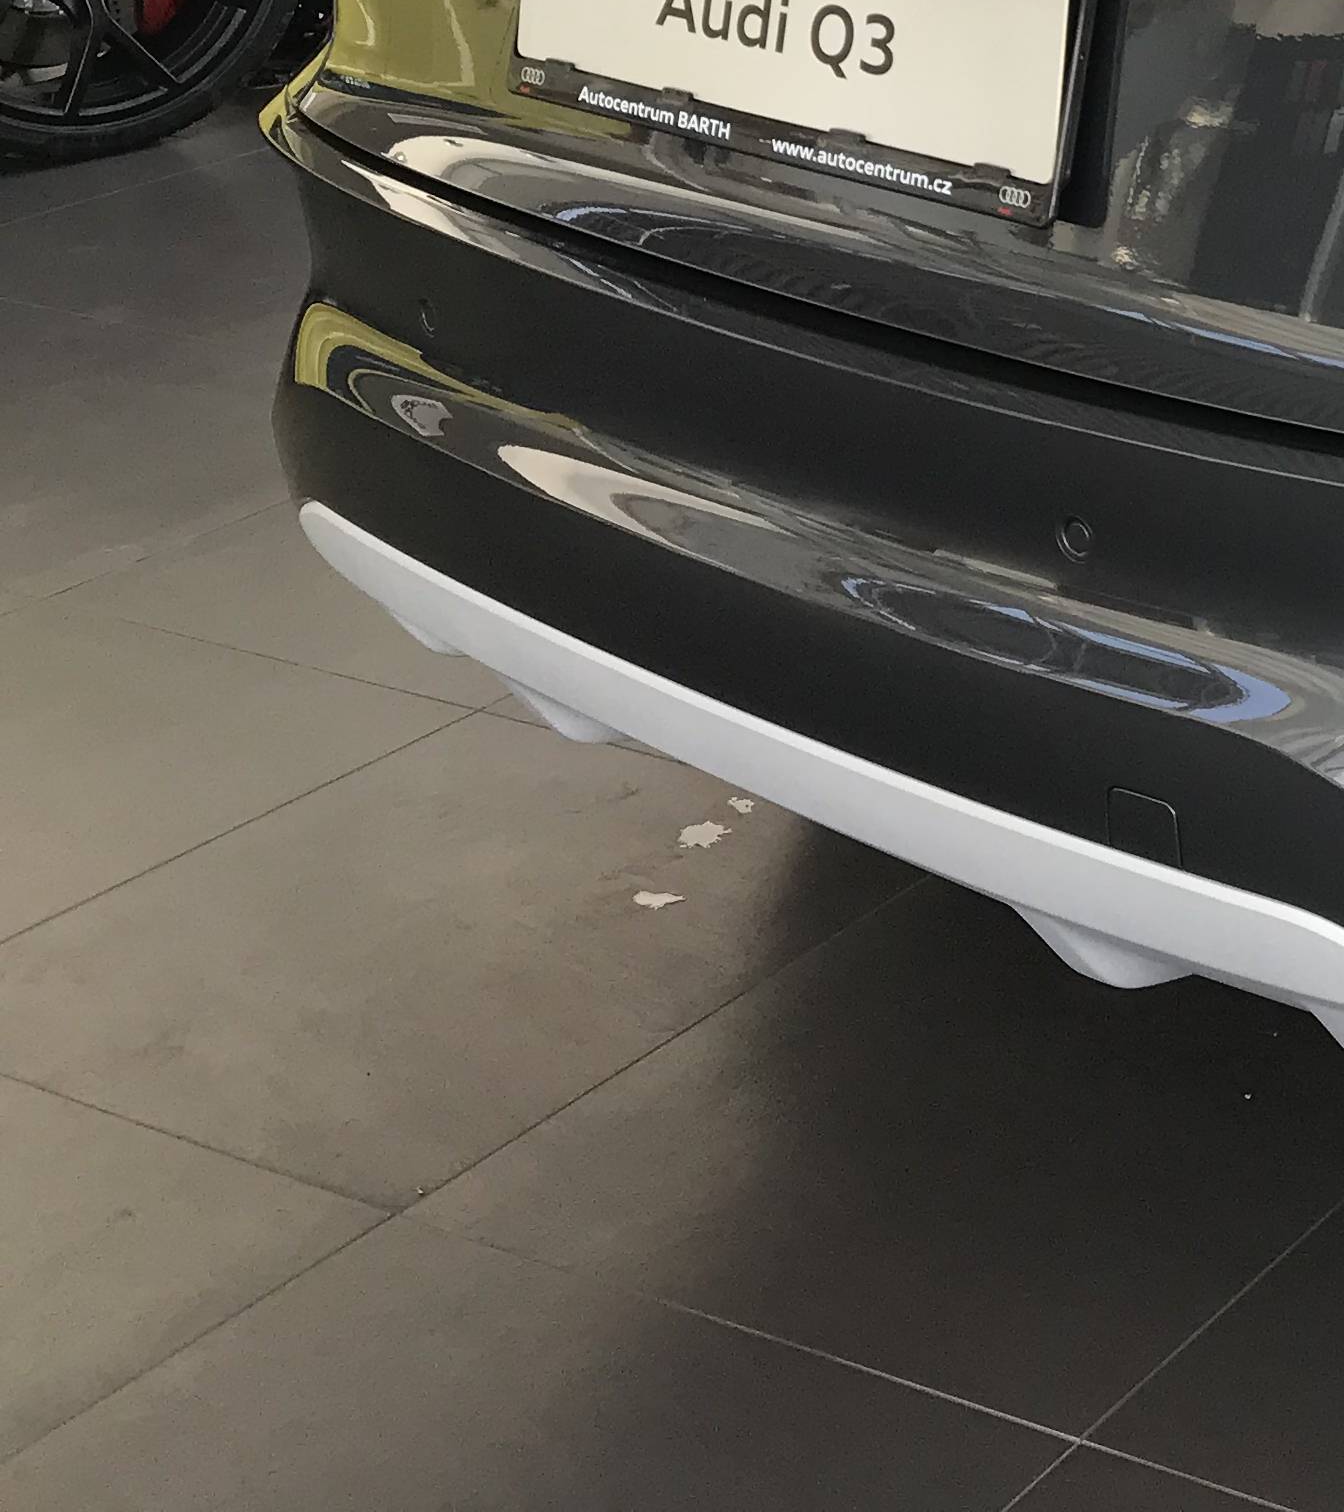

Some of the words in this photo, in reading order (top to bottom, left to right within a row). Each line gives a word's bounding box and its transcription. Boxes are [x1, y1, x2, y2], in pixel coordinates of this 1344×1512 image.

[810, 4, 896, 80] Q3
[578, 86, 675, 126] Autocentrum
[678, 110, 731, 139] BARTH
[771, 138, 953, 195] www.autocentrum.cz
